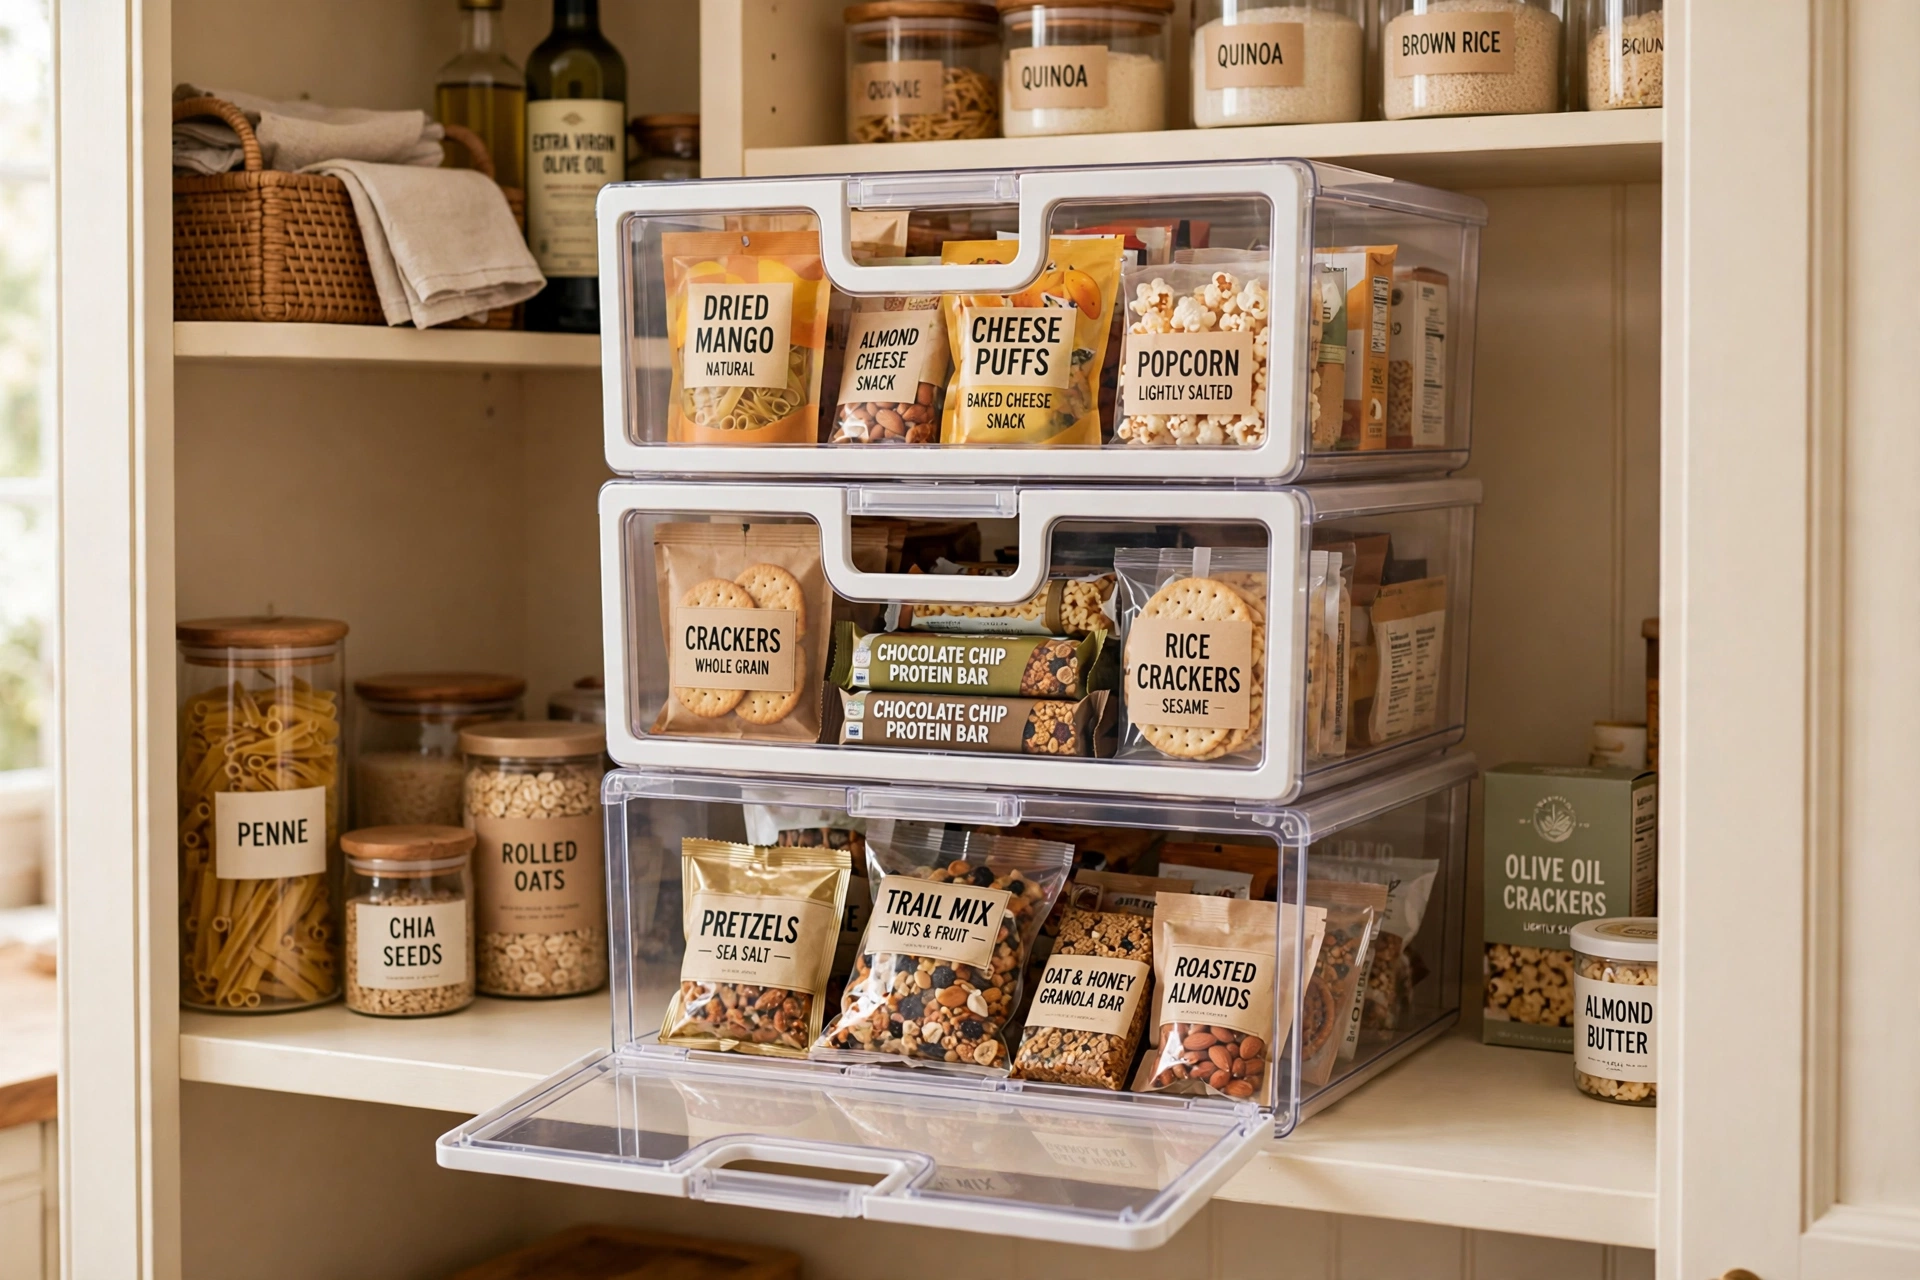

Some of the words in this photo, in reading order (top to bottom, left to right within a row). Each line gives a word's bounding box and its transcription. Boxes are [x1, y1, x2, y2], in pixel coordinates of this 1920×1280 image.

[1217, 42, 1284, 68] QUINOA
[1402, 32, 1456, 57] BROWN
[1462, 30, 1501, 54] RICE
[1022, 63, 1089, 91] QUINOA
[532, 132, 569, 152] EXTRA
[574, 133, 616, 153] VIRGIN
[543, 154, 580, 174] OLIVE
[584, 155, 607, 174] OIL
[703, 294, 769, 321] DRIED
[695, 326, 774, 354] MANGO
[859, 327, 920, 350] ALMOND
[971, 316, 1063, 344] CHEESE
[705, 361, 755, 377] NATURAL
[855, 350, 909, 371] CHEESE
[975, 347, 1050, 377] PUFFS
[1137, 349, 1240, 378] POPCORN
[855, 374, 897, 392] SNACK
[1138, 384, 1185, 401] LIGHTLY
[1188, 384, 1233, 401] SALTED
[967, 391, 1003, 408] BAKED
[1005, 392, 1053, 410] CHEESE
[986, 412, 1026, 430] SNACK
[685, 625, 781, 654] CRACKERS
[1165, 632, 1211, 660] RICE
[695, 657, 733, 674] WHOLE
[735, 659, 770, 676] GRAIN
[877, 643, 966, 664] CHOCOLATE
[968, 646, 1007, 666] CHIP
[889, 663, 953, 684] PROTEIN
[957, 666, 989, 686] BAR
[1137, 663, 1241, 694] CRACKERS
[873, 699, 966, 722] CHOCOLATE
[968, 703, 1008, 723] CHIP
[1162, 697, 1210, 716] SESAME
[886, 720, 952, 742] PROTEIN
[956, 723, 989, 744] BAR
[237, 818, 309, 847] PENNE
[501, 839, 579, 865] ROLLED
[514, 868, 566, 892] OATS
[1505, 853, 1565, 883] OLIVE
[1571, 858, 1605, 886] OIL
[886, 889, 943, 920] TRAIL
[948, 897, 995, 927] MIX
[1503, 884, 1607, 917] CRACKERS
[389, 915, 436, 939] CHIA
[700, 909, 800, 944] PRETZELS
[889, 920, 921, 938] NUTS
[922, 923, 932, 939] &
[934, 925, 970, 944] FRUIT
[383, 942, 443, 967] SEEDS
[715, 944, 738, 961] SEA
[740, 945, 772, 964] SALT
[1044, 967, 1073, 985] OAT
[1071, 969, 1083, 986] &
[1085, 970, 1137, 992] HONEY
[1174, 956, 1257, 984] ROASTED
[1039, 987, 1095, 1008] GRANOLA
[1097, 993, 1125, 1013] BAR
[1167, 982, 1251, 1011] ALMONDS
[1585, 994, 1653, 1025] ALMOND
[1587, 1023, 1648, 1055] BUTTER
